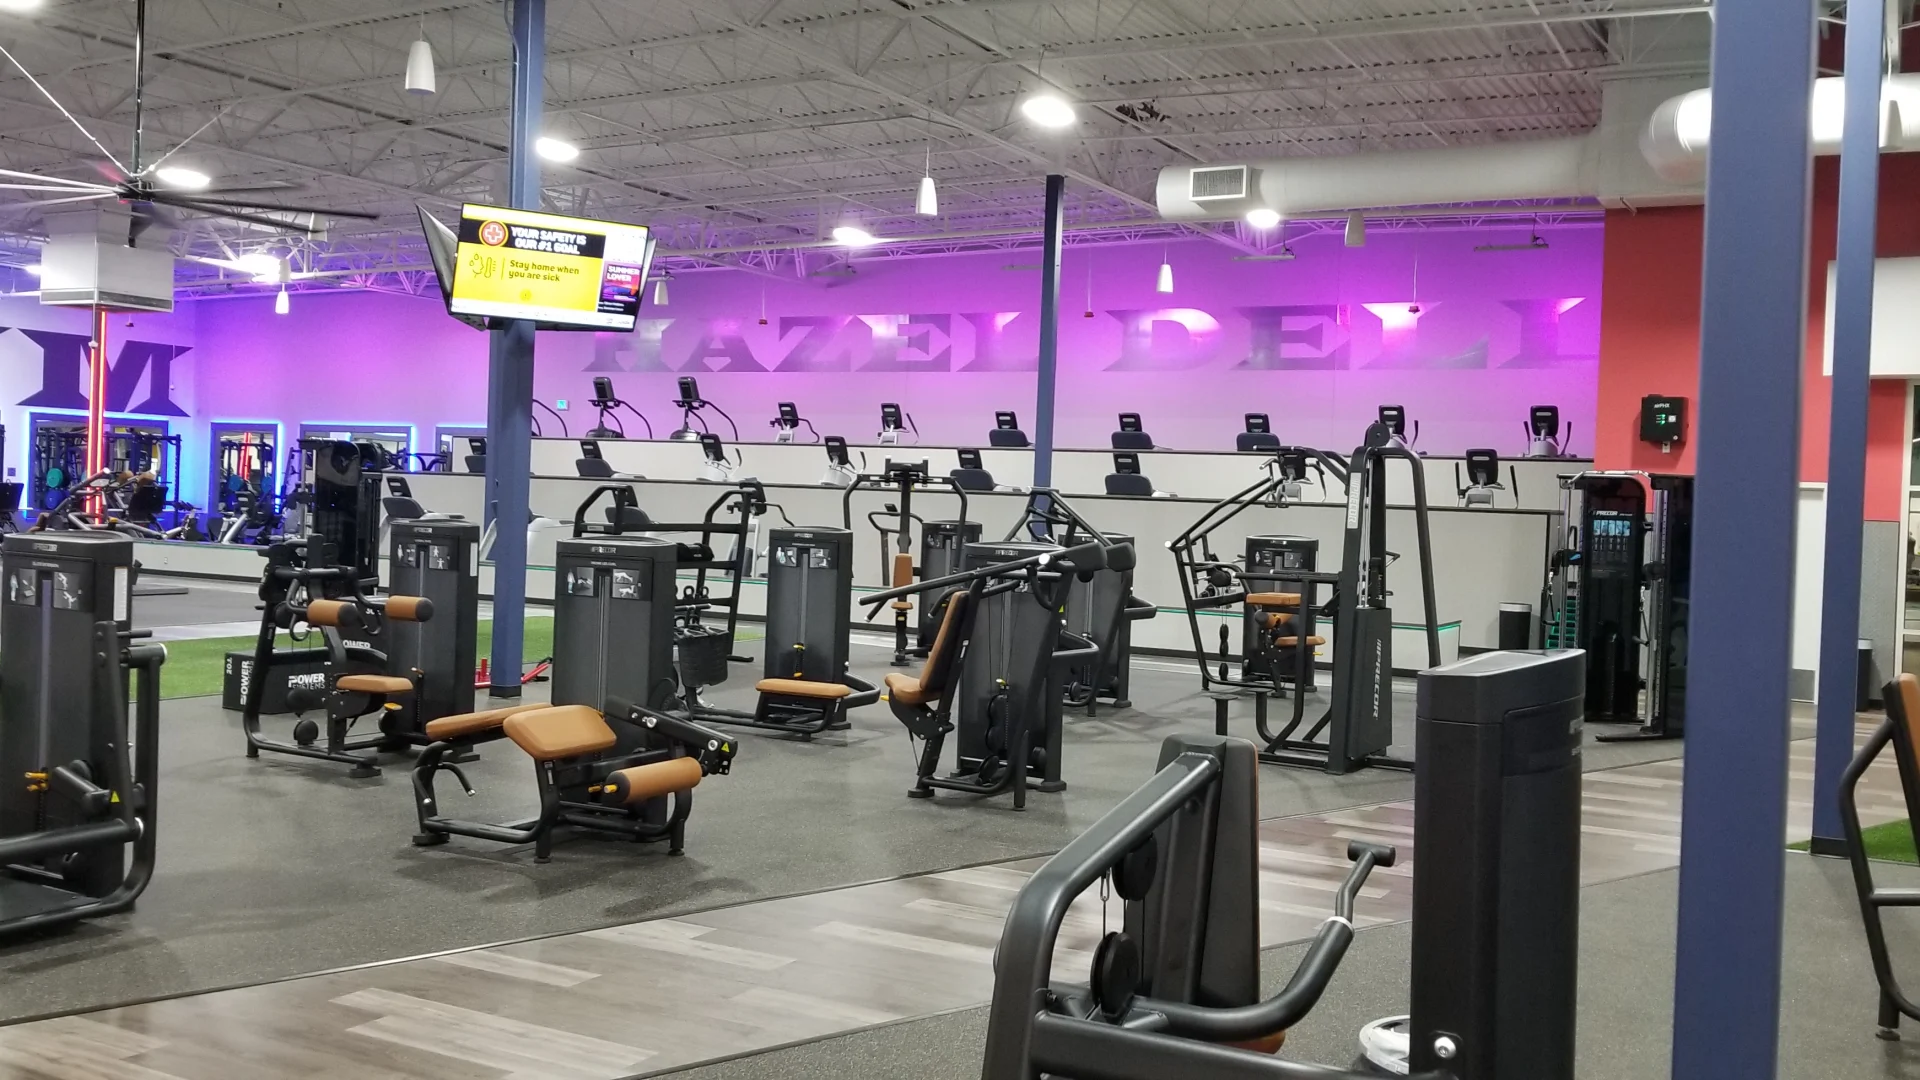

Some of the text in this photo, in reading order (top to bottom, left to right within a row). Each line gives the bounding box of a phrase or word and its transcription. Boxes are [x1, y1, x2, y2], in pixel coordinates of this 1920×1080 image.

[510, 226, 587, 246] YOUR SAFETY IS
[514, 237, 580, 255] OUR #1 GOAL
[508, 270, 560, 282] you are sick
[510, 260, 579, 275] Stay home when
[581, 297, 1598, 373] HAZEL DELL
[0, 326, 193, 417] M
[288, 672, 325, 688] POWER
[1373, 649, 1382, 718] PRECOR
